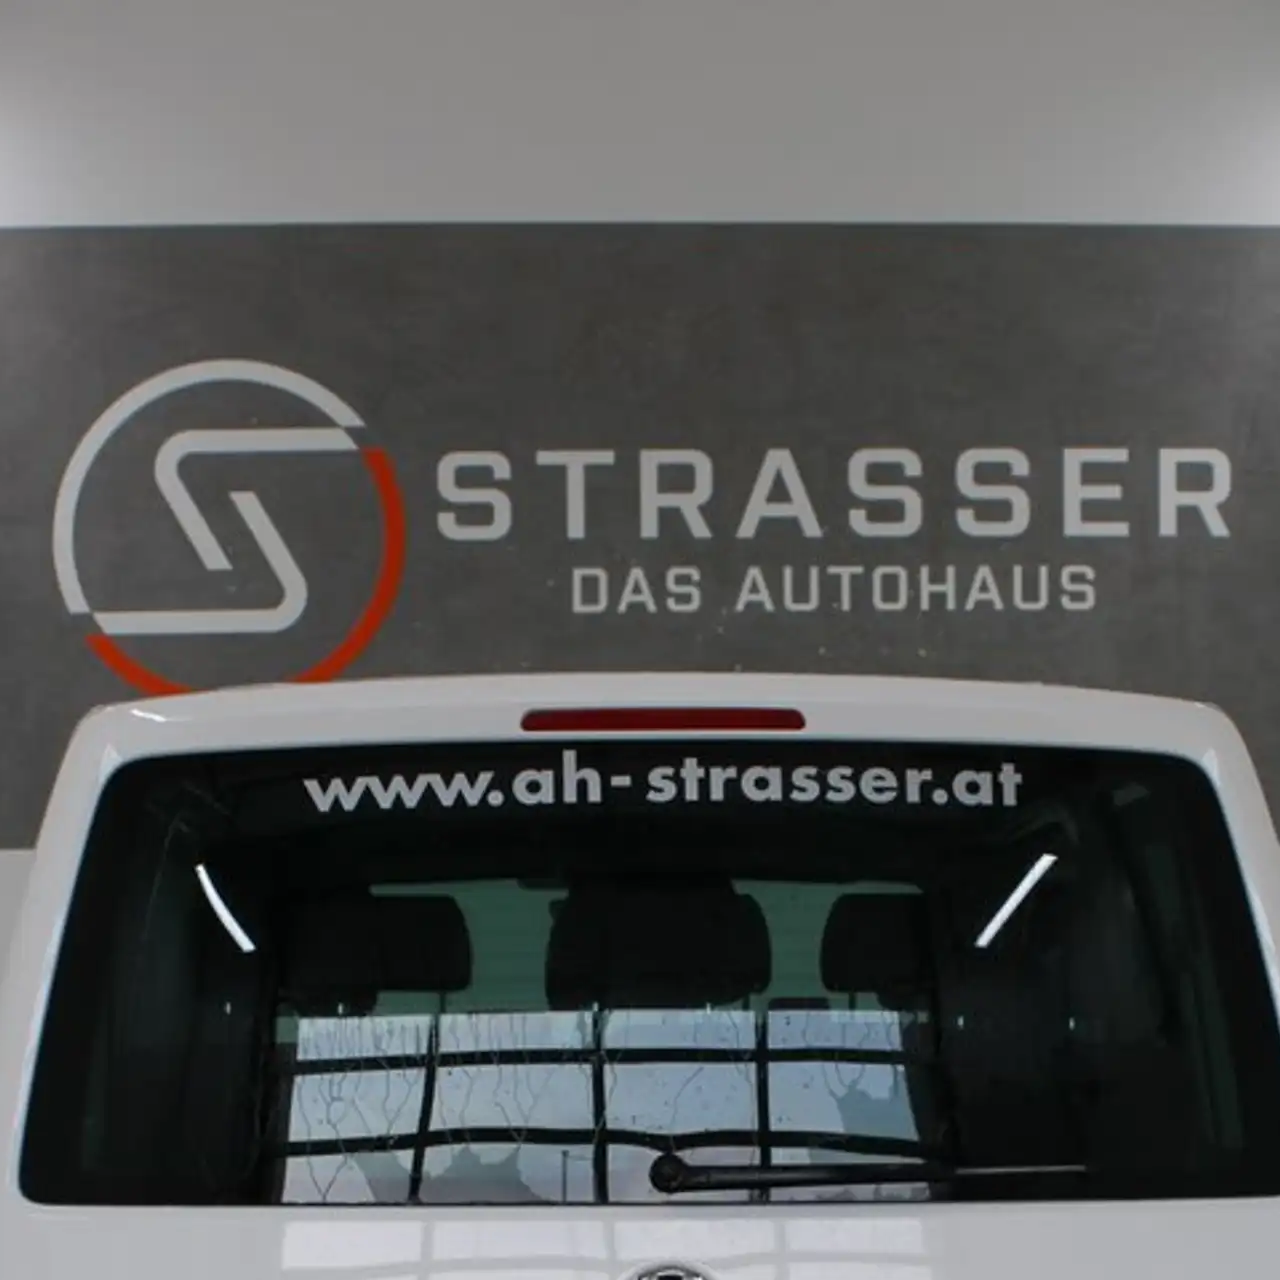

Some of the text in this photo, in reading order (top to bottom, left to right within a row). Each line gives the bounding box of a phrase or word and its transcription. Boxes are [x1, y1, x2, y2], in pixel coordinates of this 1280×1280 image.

[436, 447, 1233, 541] STRASSER
[572, 563, 1097, 614] DAS AUTOHAUS
[303, 749, 1023, 813] www.ah-strasser.at
